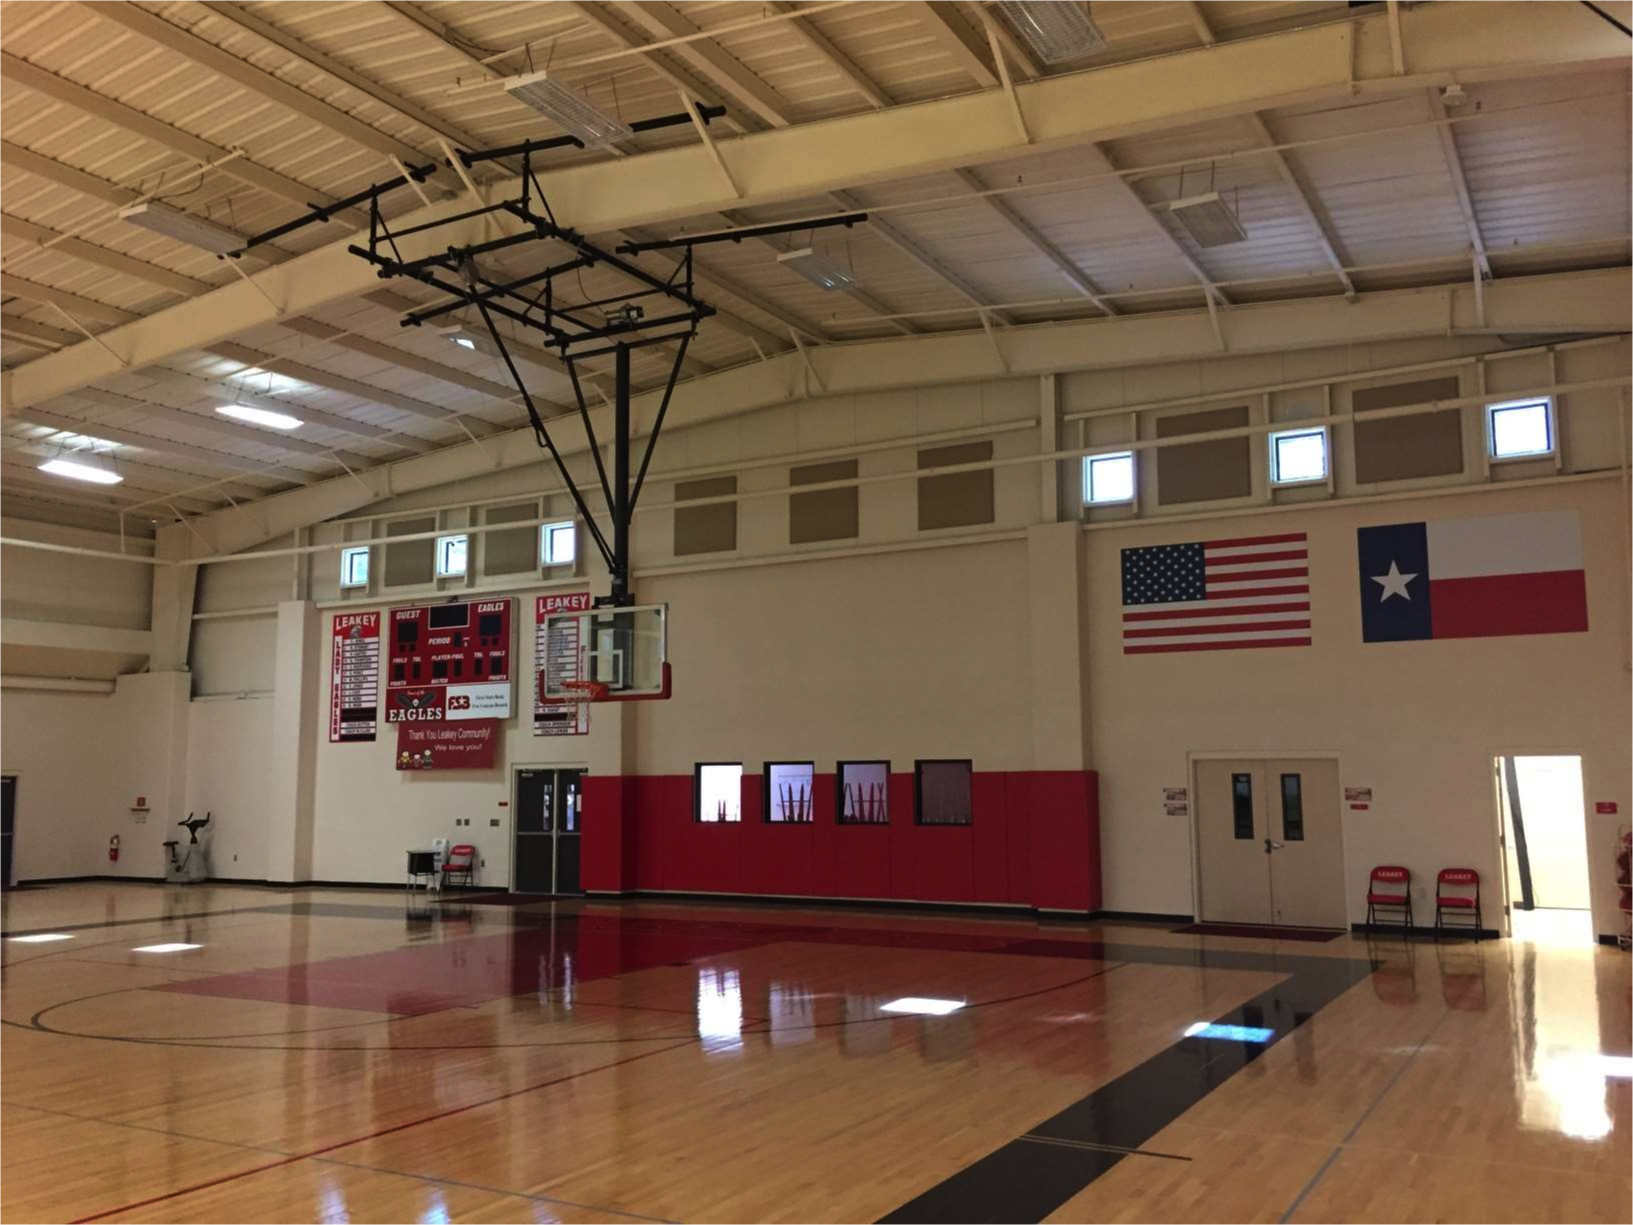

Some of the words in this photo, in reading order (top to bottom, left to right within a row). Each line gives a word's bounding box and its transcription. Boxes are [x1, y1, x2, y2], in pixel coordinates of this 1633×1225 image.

[477, 602, 505, 613] EAGLES
[539, 594, 588, 614] LEAKEY
[335, 613, 377, 631] LEAKEY
[396, 610, 421, 620] GUEST
[428, 637, 451, 645] PERIOD
[332, 683, 340, 735] EAGLES
[448, 695, 471, 710] FSB
[389, 707, 442, 721] EAGLES
[408, 729, 425, 740] Thank
[426, 729, 437, 739] You
[437, 729, 457, 741] Leakey
[458, 727, 490, 741] Community!
[466, 744, 482, 752] you!
